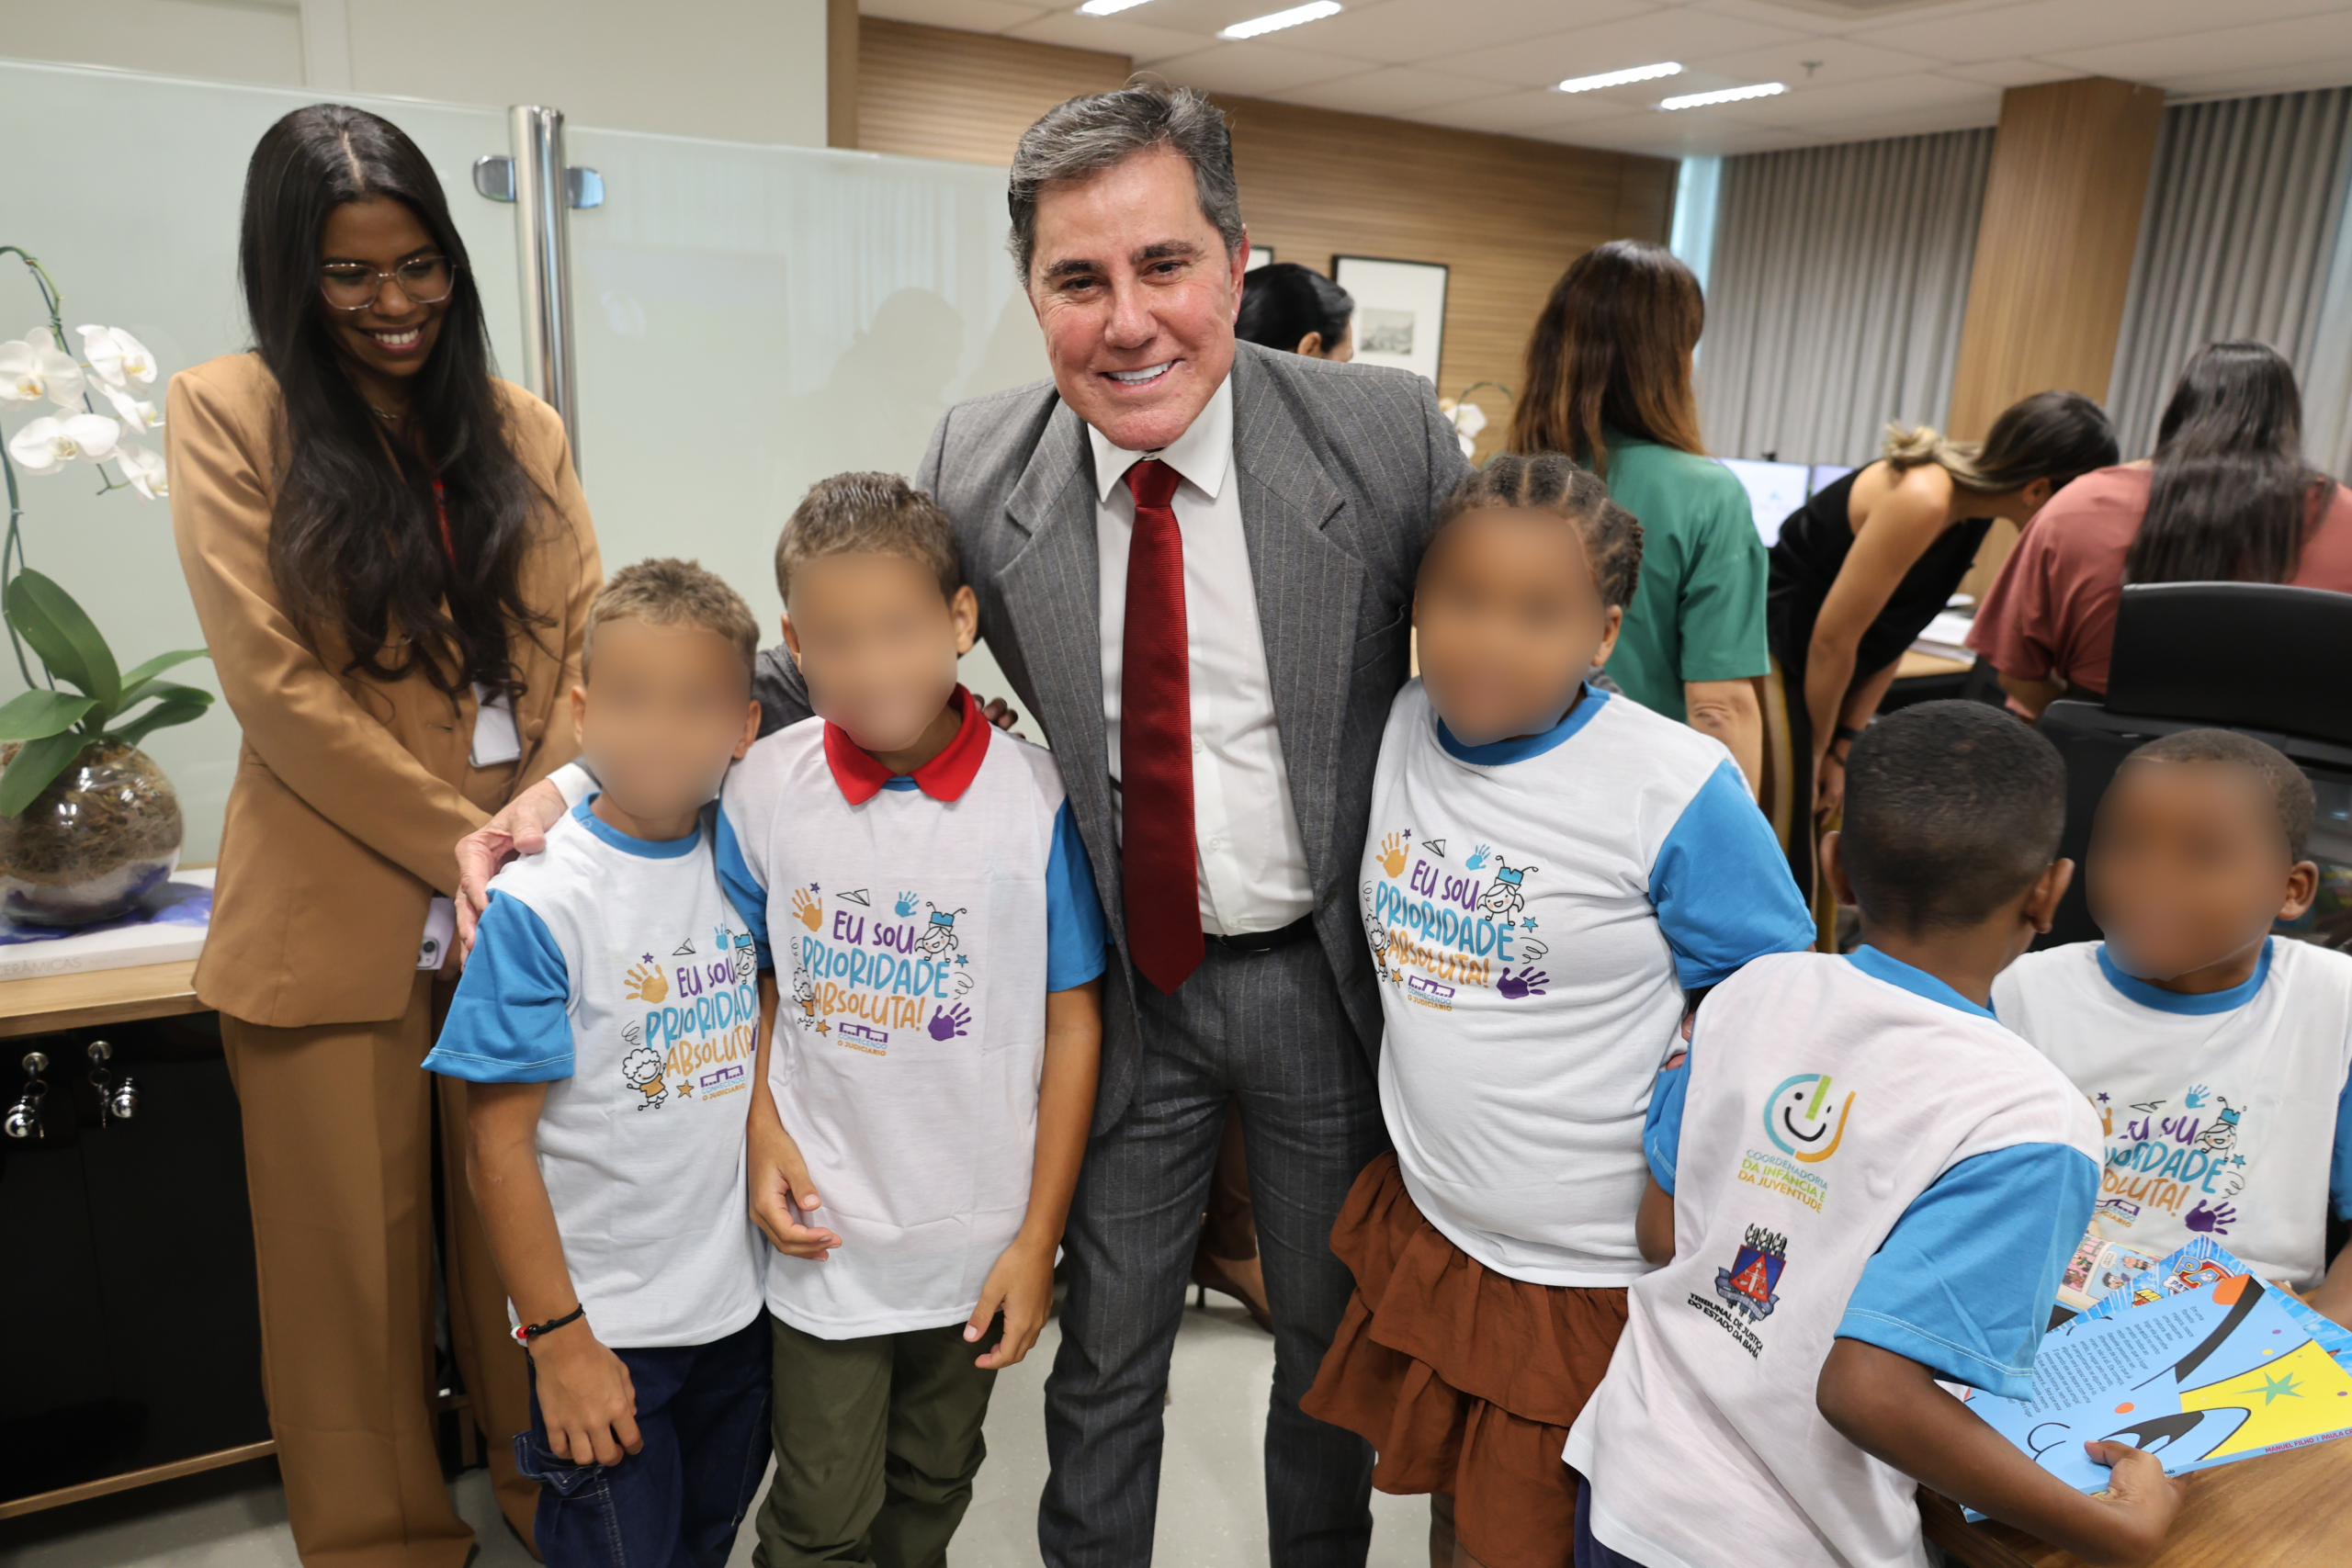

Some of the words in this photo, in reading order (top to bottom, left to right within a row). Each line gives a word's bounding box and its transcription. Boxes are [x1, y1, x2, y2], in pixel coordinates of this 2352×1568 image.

[1410, 860, 1439, 898] EU
[1442, 875, 1479, 911] SOU
[833, 910, 864, 945] EU
[873, 923, 914, 954] SOU
[1376, 881, 1514, 962] PRIORIDADE
[0, 957, 82, 977] ERÂMICAS
[803, 936, 950, 998] PRIORIDADE
[1387, 930, 1490, 988] ABSOLUTA!
[676, 965, 702, 998] EU
[707, 957, 735, 987] SOU
[814, 982, 925, 1032] ABSOLUTA!
[1408, 987, 1452, 1006] CONHECENDO
[838, 1032, 888, 1049] CONHECENDO
[701, 1076, 745, 1094] CONHECENDO
[1742, 1158, 1759, 1173] DA
[1819, 1190, 1826, 1202] E
[1746, 1149, 1827, 1190] COORDENADORIA
[1738, 1170, 1755, 1184] DA
[1758, 1177, 1823, 1213] JUVENTUDE
[2172, 1255, 2225, 1288] PA
[1690, 1292, 1733, 1322] TRIBUNAL
[1733, 1317, 1744, 1330] DE
[2143, 1321, 2153, 1329] logo
[2195, 1313, 2204, 1321] uma
[1688, 1298, 1702, 1310] DO
[1703, 1307, 1734, 1333] ESTADO
[1732, 1330, 1742, 1344] DA
[1742, 1339, 1758, 1360] BAHIA
[2089, 1338, 2098, 1349] viram,
[2135, 1339, 2145, 1350] todos
[2139, 1330, 2150, 1339] está
[2150, 1344, 2160, 1355] ninho
[2165, 1332, 2174, 1341] Mas
[2183, 1326, 2194, 1337] nasce
[2062, 1347, 2073, 1359] alguém
[2070, 1359, 2079, 1368] será
[2075, 1368, 2086, 1378] capaz
[2080, 1341, 2089, 1353] então,
[2089, 1355, 2099, 1365] vagar
[2095, 1365, 2105, 1373] pelo
[2102, 1373, 2113, 1386] mundo,
[2113, 1356, 2121, 1365] tudo
[2116, 1329, 2126, 1339] redor
[2123, 1339, 2134, 1350] dizem
[2139, 1359, 2149, 1370] lugar
[2042, 1352, 2054, 1364] pessoa
[2055, 1371, 2064, 1381] pode
[2054, 1352, 2066, 1365] quando
[2069, 1376, 2081, 1388] depara
[2083, 1395, 2091, 1404] uma
[2092, 1375, 2102, 1386] algum
[2032, 1387, 2041, 1396] pode
[2039, 1396, 2049, 1408] mesmo
[2033, 1370, 2043, 1382] parece
[2044, 1387, 2053, 1396] Será
[2053, 1403, 2062, 1411] essa
[2042, 1368, 2052, 1378] nesta
[2063, 1399, 2071, 1407] tudo
[2024, 1408, 2033, 1417] lugar
[2265, 1442, 2293, 1453] MANUEL
[2294, 1438, 2314, 1447] FILHO
[2321, 1430, 2344, 1440] PAULA
